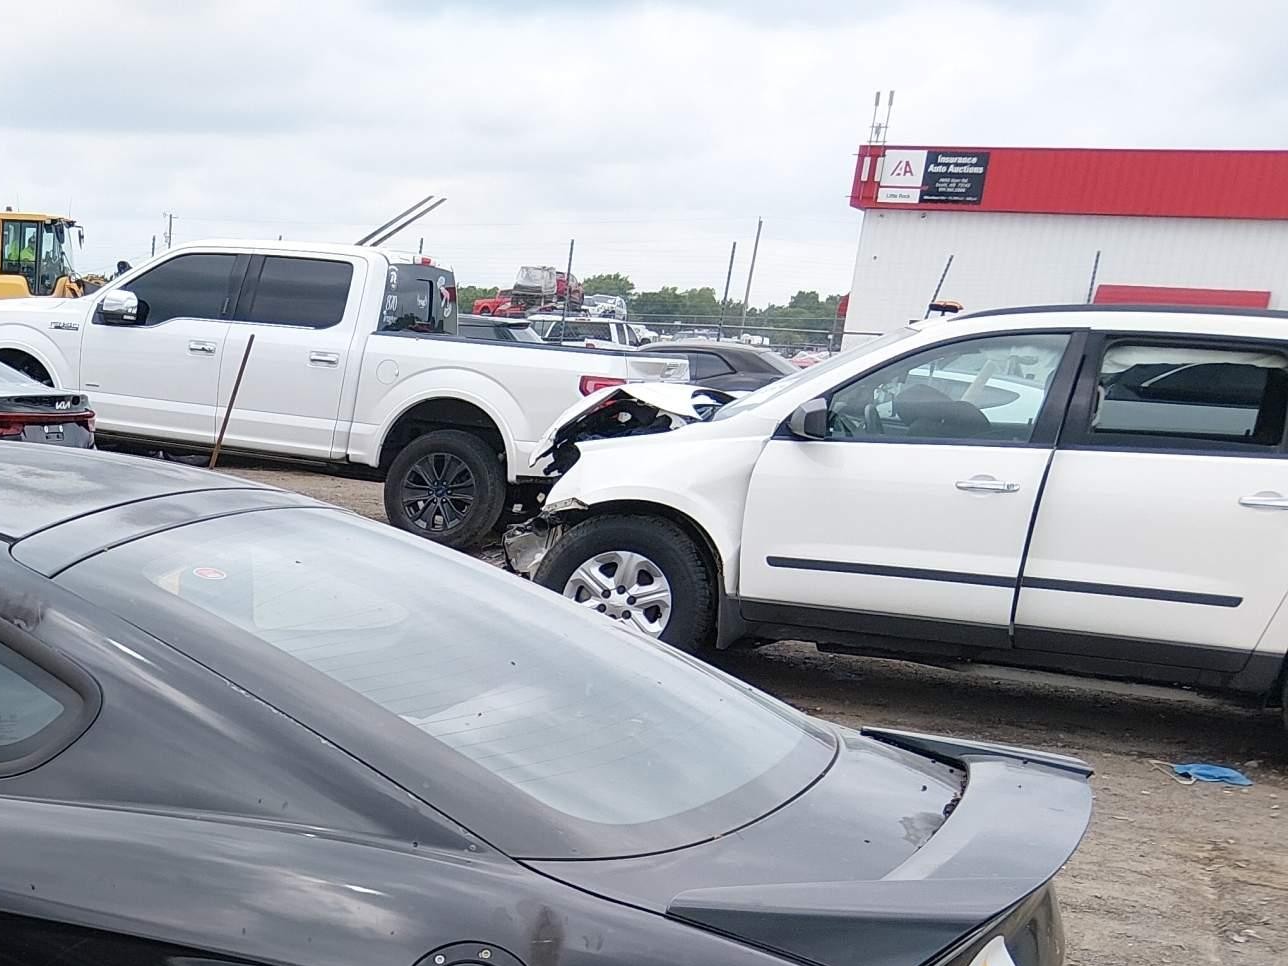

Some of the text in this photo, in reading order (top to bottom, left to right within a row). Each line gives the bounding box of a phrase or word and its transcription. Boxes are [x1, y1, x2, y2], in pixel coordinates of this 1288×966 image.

[937, 154, 978, 164] Insurance
[927, 163, 984, 174] Auto Auctions
